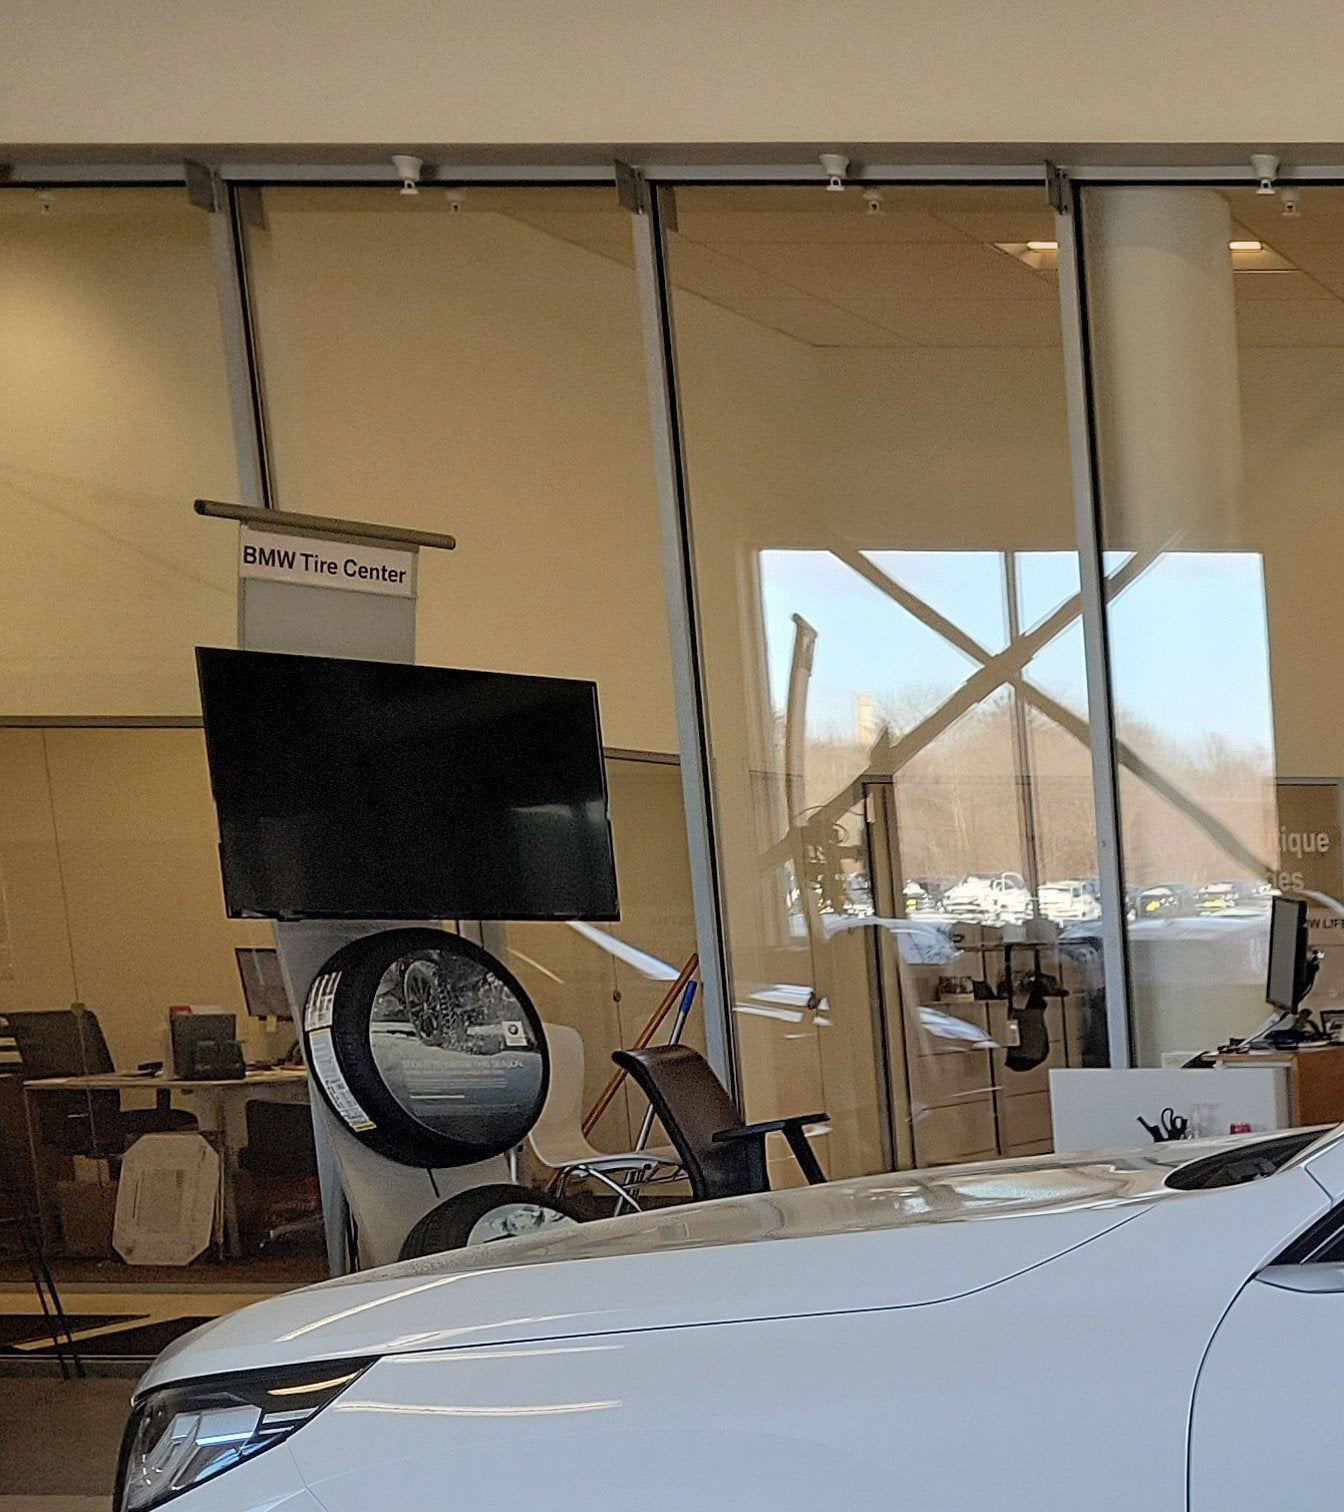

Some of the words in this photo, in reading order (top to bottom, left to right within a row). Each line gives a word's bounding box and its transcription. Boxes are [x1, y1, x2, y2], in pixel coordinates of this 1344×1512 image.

[242, 545, 296, 570] BMW
[301, 553, 338, 576] Tire
[343, 559, 407, 585] Center
